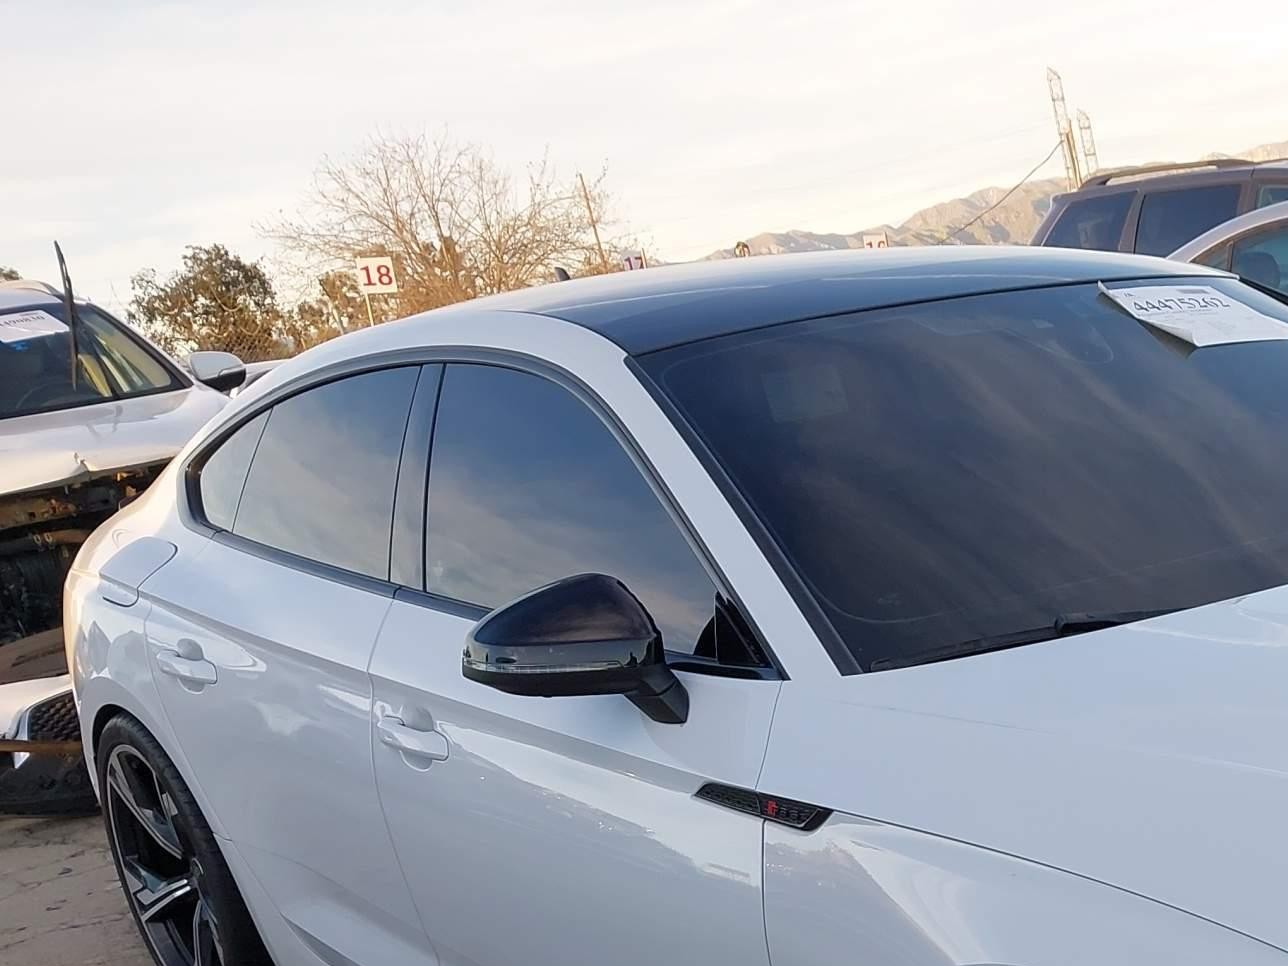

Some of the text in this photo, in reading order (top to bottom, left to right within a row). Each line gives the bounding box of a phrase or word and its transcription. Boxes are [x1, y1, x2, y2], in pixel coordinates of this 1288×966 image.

[624, 256, 645, 270] 17
[360, 264, 393, 286] 18
[1133, 297, 1231, 312] 44475262
